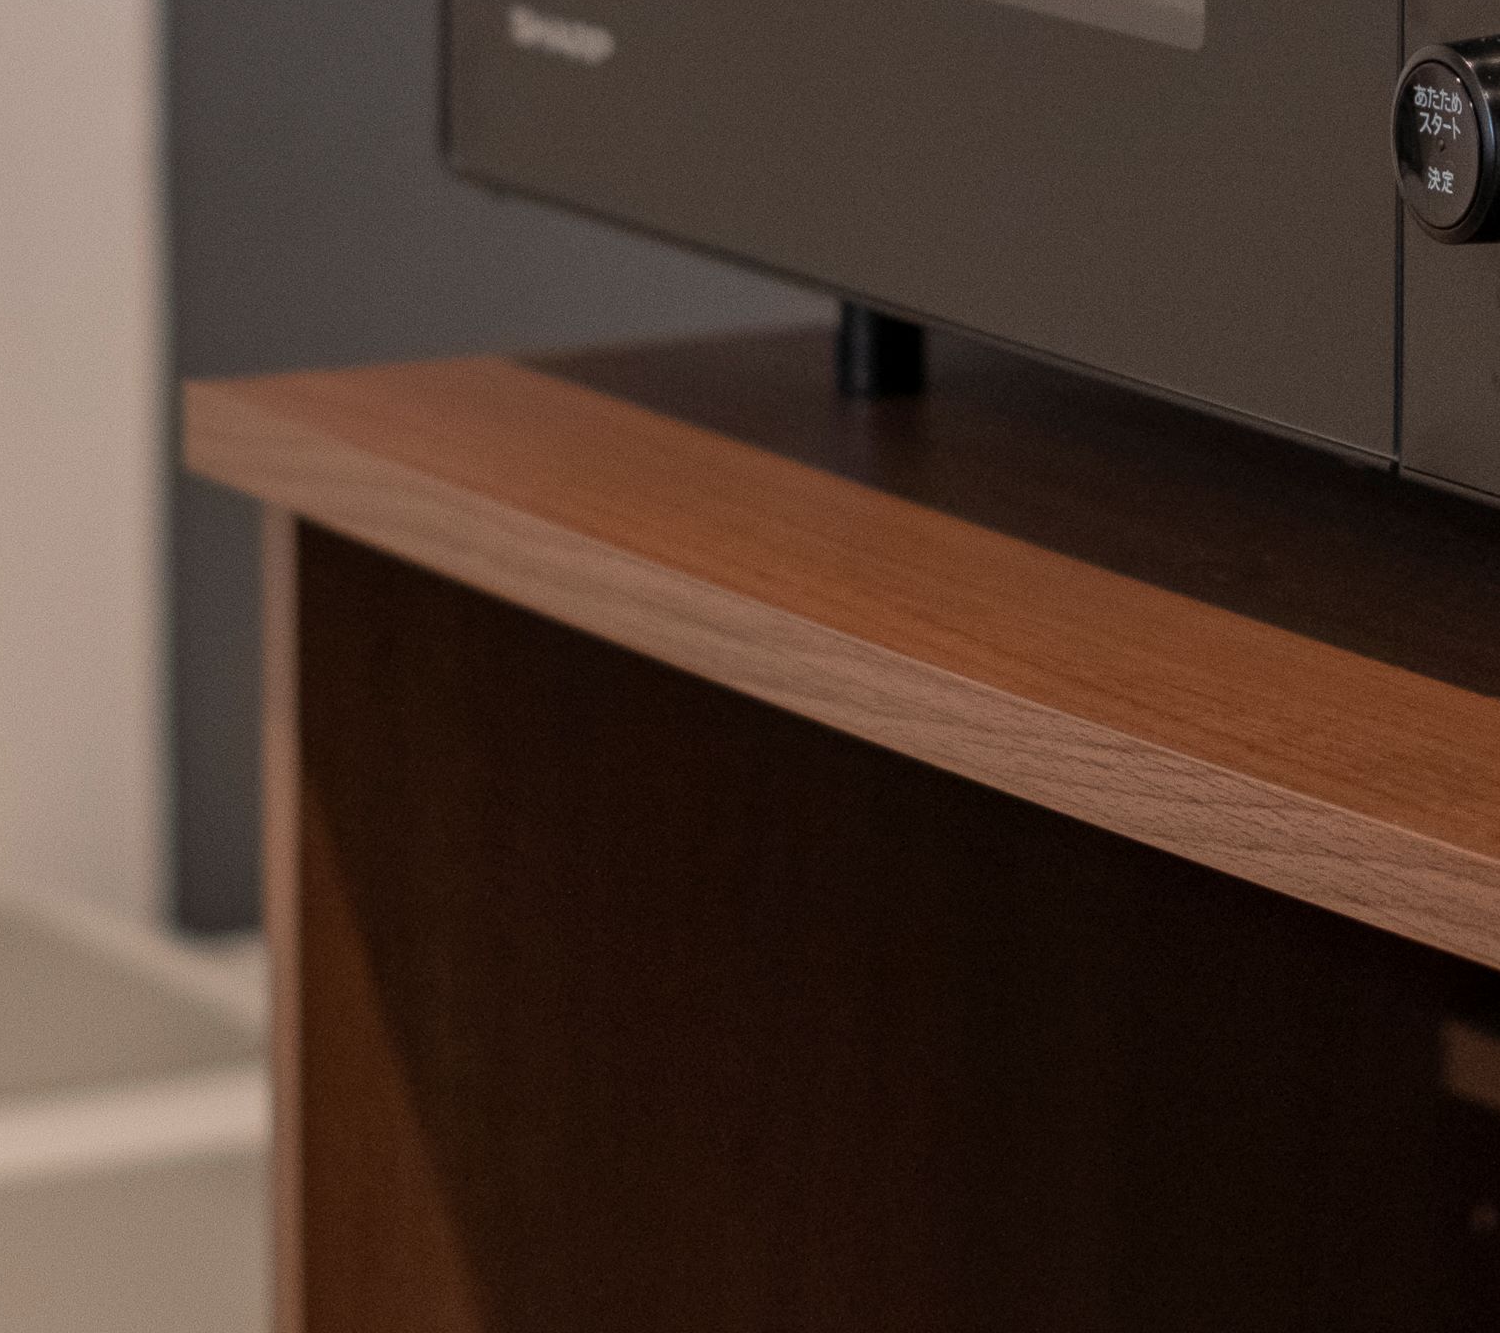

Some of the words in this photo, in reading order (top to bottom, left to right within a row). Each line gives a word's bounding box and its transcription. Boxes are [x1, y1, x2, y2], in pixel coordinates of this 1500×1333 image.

[1413, 84, 1462, 115] あたため
[1420, 111, 1461, 140] スタート
[1428, 166, 1454, 194] 決定
